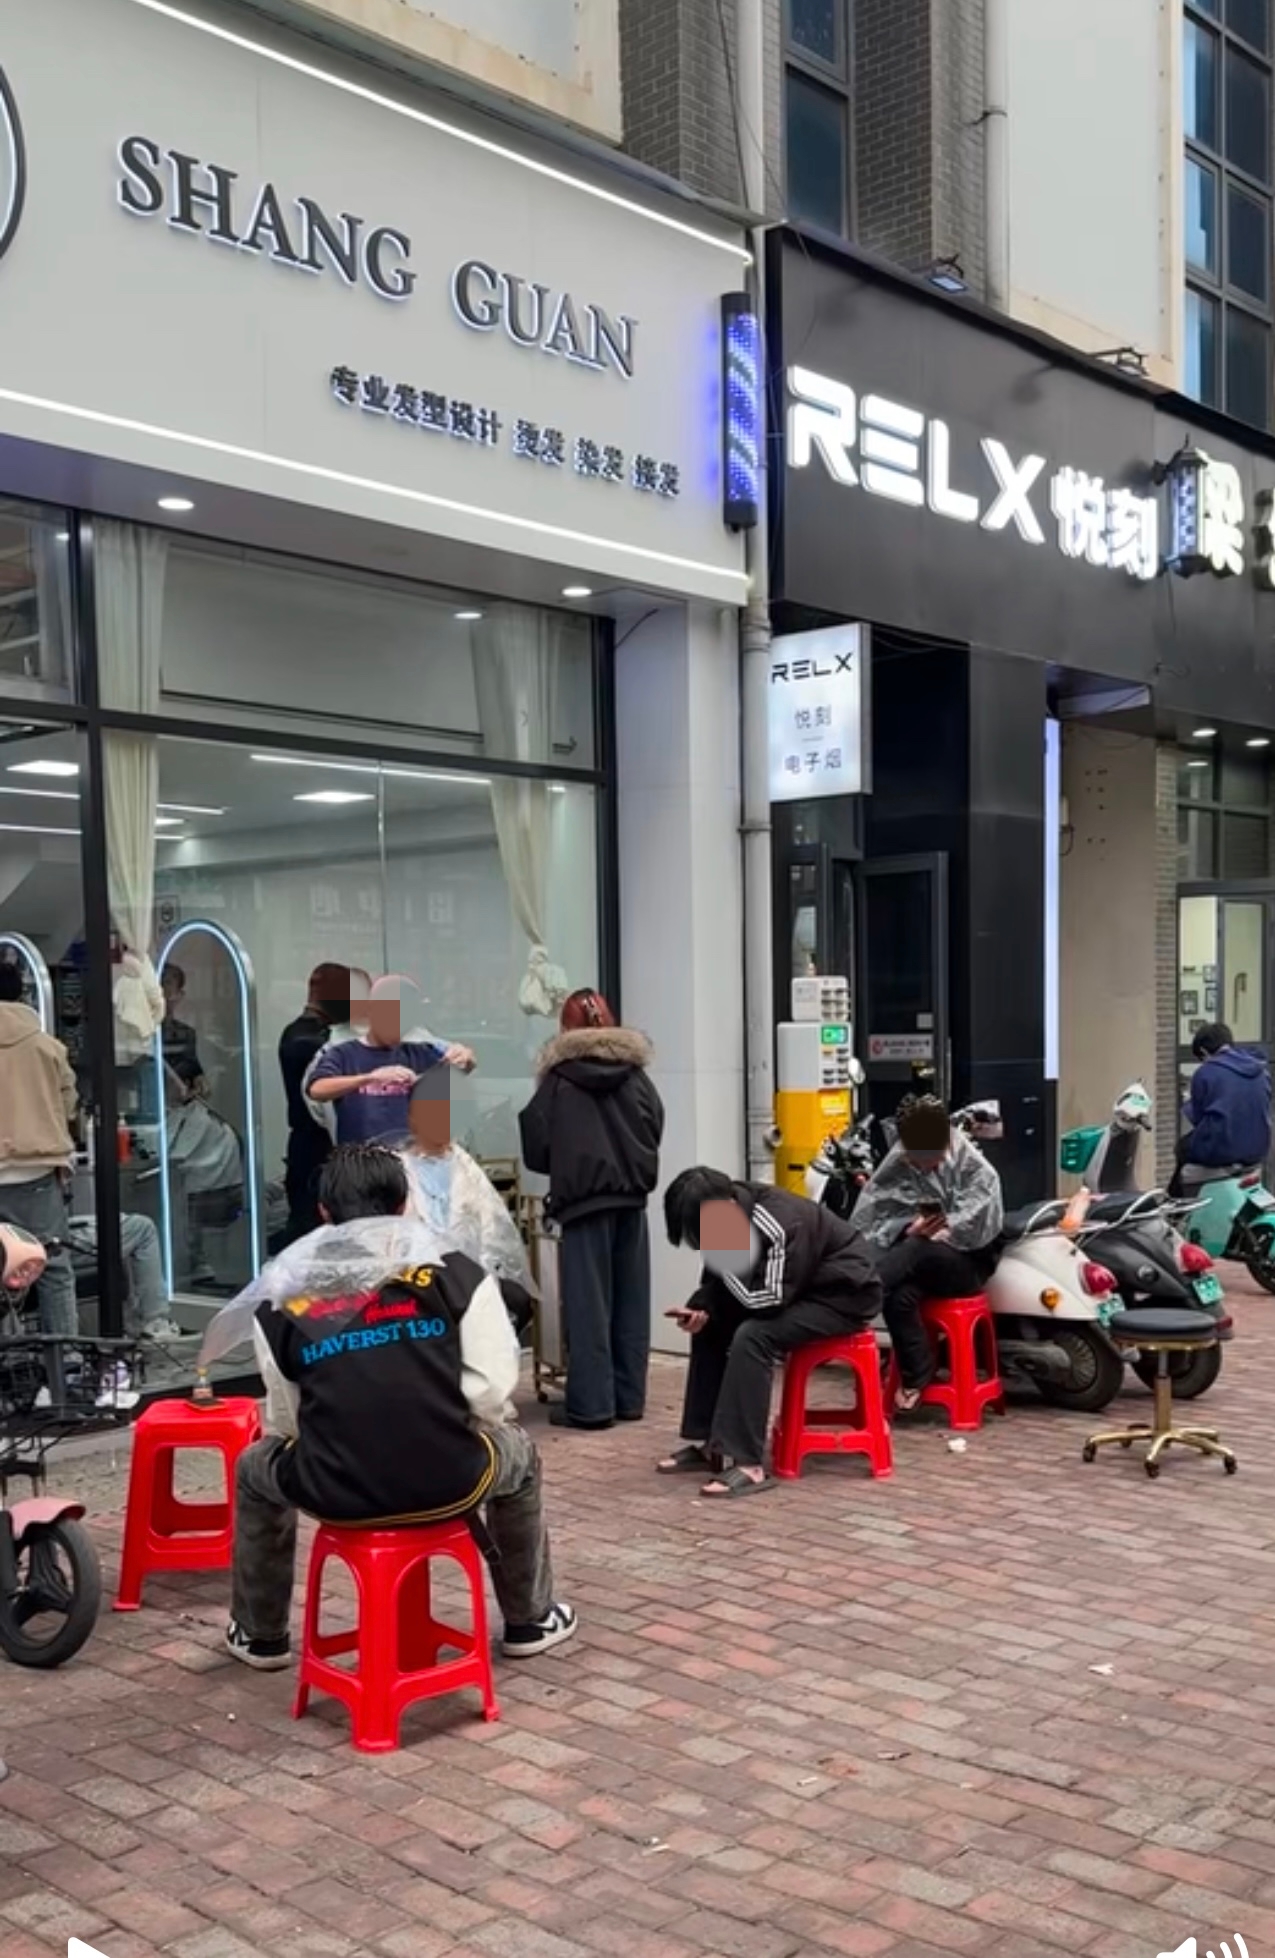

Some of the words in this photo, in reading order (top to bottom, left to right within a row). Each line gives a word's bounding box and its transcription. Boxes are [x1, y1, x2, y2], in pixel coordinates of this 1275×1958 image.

[117, 137, 417, 299] SHANG
[453, 260, 639, 377] GUAN
[330, 365, 502, 445] 专业发型设计
[512, 418, 565, 466] 烫发
[787, 366, 1046, 544] RELX
[1050, 466, 1158, 580] 悦刻
[772, 652, 854, 684] RELX
[794, 704, 832, 730] 悦刻
[784, 748, 842, 775] 电子烟
[303, 1323, 401, 1365] HAVERST
[406, 1318, 446, 1339] 130
